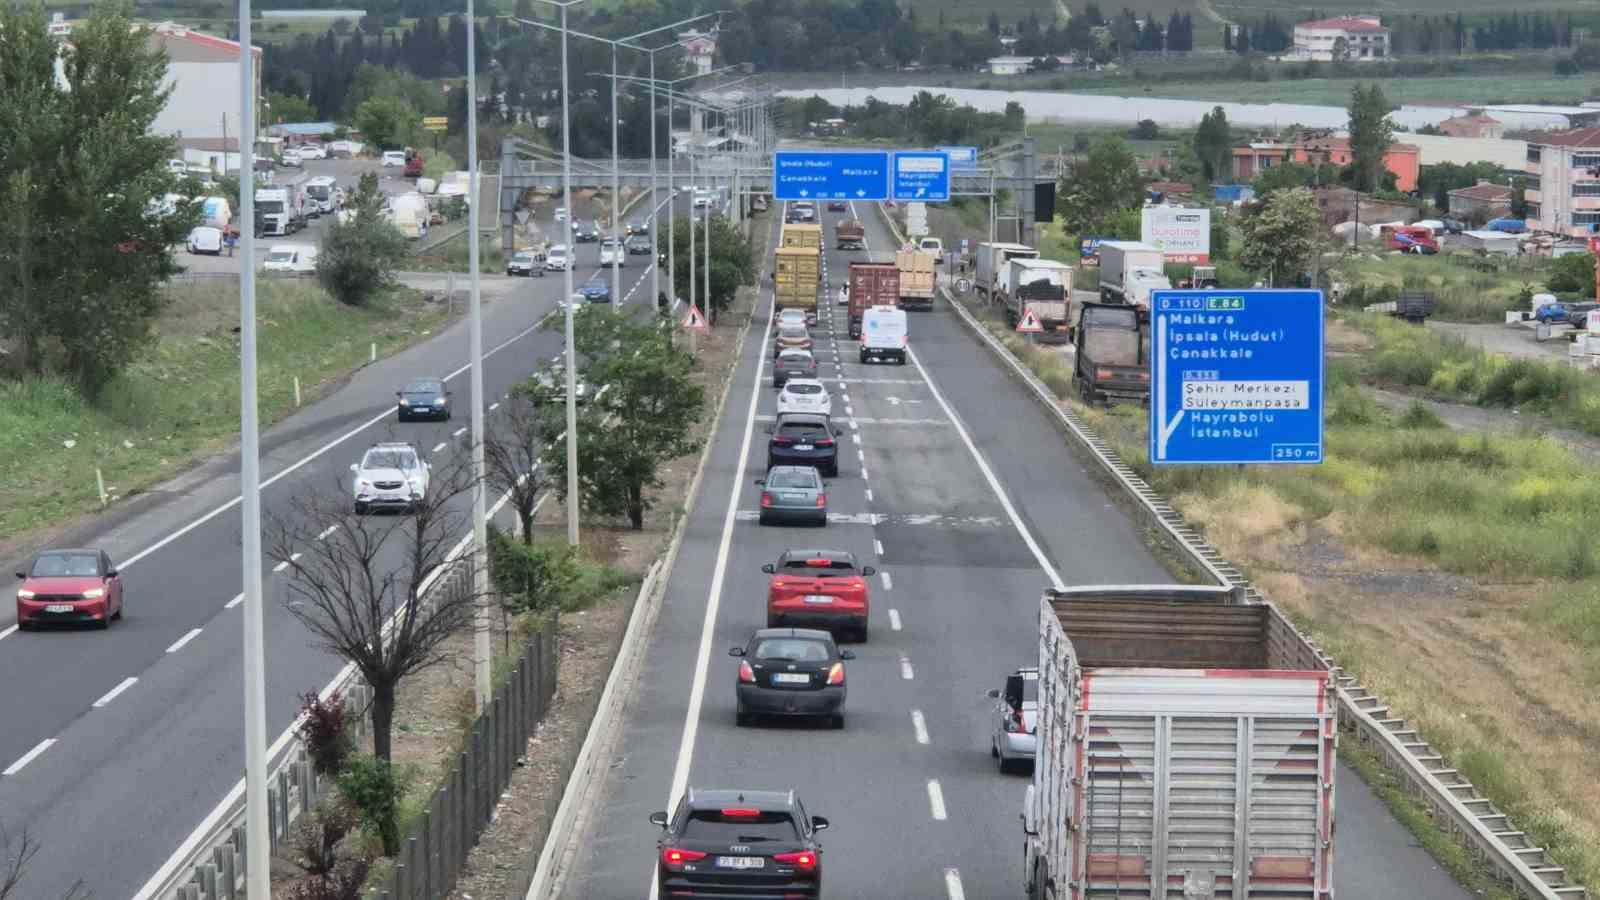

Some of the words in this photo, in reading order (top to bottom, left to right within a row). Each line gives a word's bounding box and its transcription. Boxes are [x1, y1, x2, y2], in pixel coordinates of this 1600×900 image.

[1170, 313, 1234, 324] Malkara
[1170, 328, 1218, 343] İpsala
[1223, 327, 1284, 342] (Hudut)
[1170, 347, 1253, 359] Çanakkale
[1185, 383, 1225, 394] Şehir
[1234, 383, 1296, 393] Merkezi
[1191, 411, 1275, 424] Hayrabolu
[1191, 424, 1258, 438] İstanbul
[1276, 449, 1301, 458] 250
[1305, 450, 1318, 458] m
